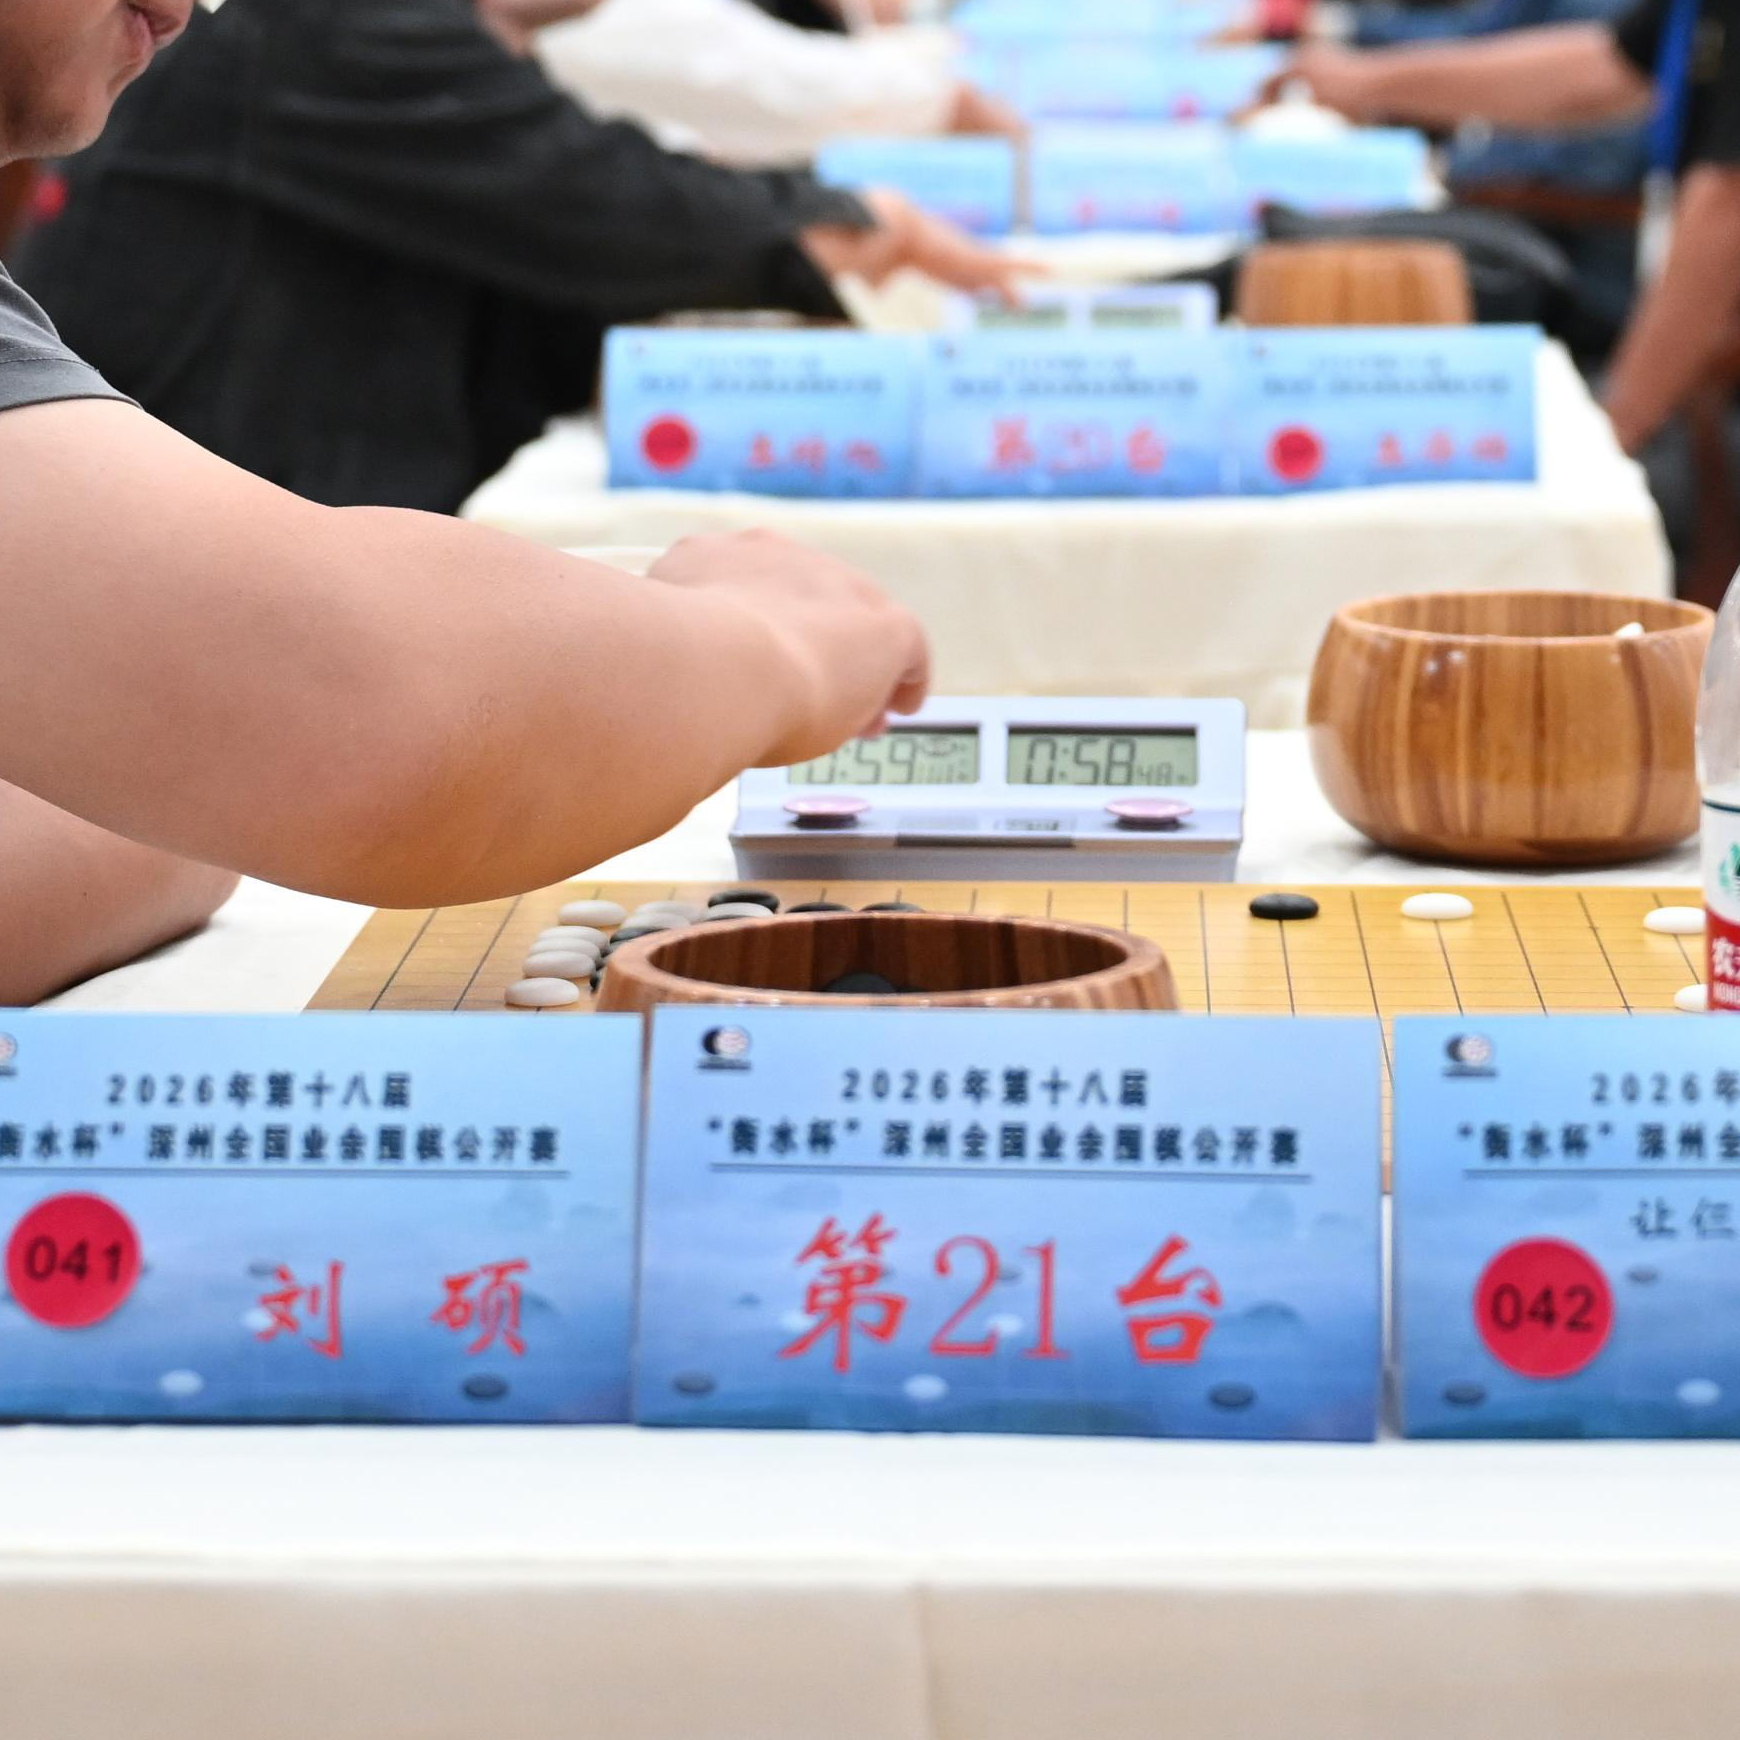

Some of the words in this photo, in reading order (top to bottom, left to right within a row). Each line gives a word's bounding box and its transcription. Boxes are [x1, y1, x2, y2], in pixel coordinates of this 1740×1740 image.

[107, 1071, 411, 1109] 2026年第十八届
[842, 1068, 1147, 1108] 2026年第十八届
[25, 1236, 123, 1282] 041
[779, 1213, 1224, 1374] 第21台
[1491, 1283, 1596, 1333] 042
